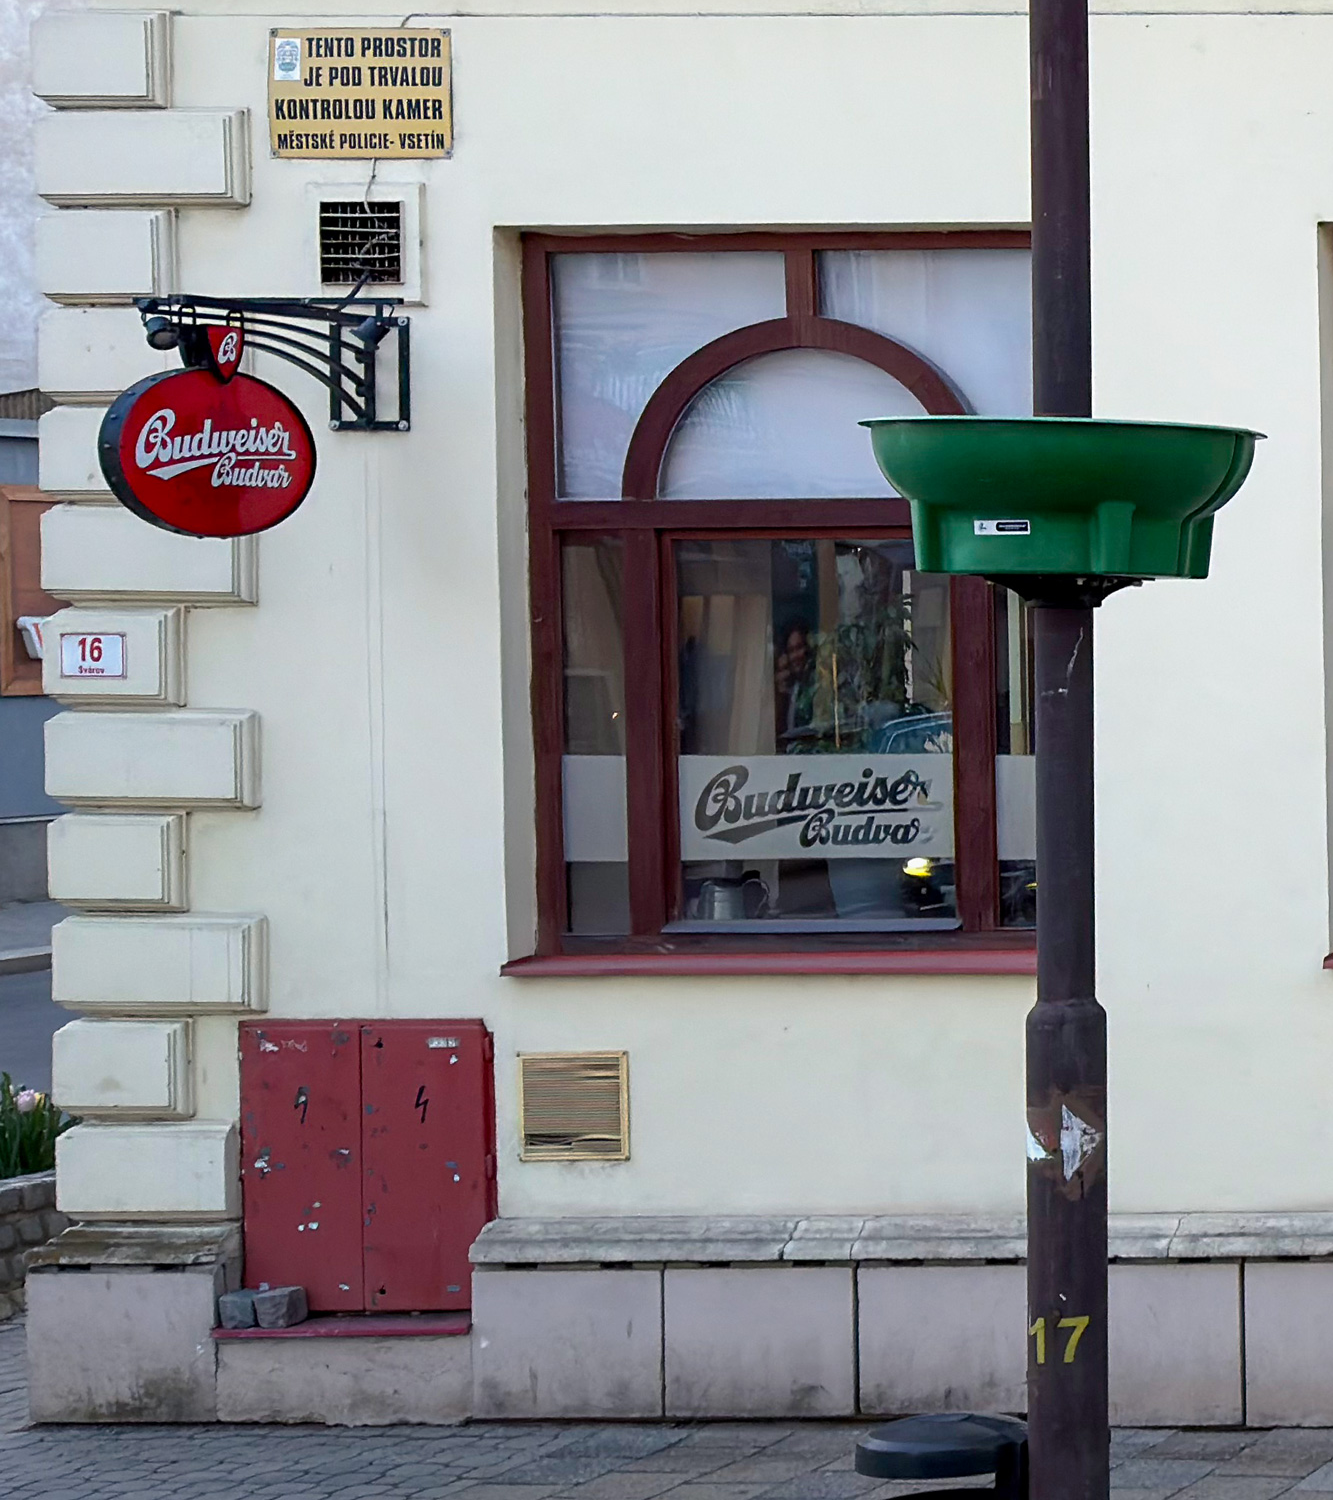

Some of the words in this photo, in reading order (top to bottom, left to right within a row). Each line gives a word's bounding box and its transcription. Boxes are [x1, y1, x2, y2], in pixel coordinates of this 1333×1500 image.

[305, 37, 355, 58] TENTO
[361, 37, 442, 58] PROSTOR
[303, 66, 323, 87] JE
[328, 66, 362, 87] POD
[368, 66, 443, 87] TRVALOU
[274, 98, 376, 120] KONTROLOU
[382, 98, 443, 120] KAMER
[277, 130, 336, 150] MĚSTSKÉ
[398, 130, 446, 150] VSETÍN
[135, 408, 297, 470] Budweiser
[210, 451, 293, 489] Budvar
[77, 637, 103, 663] 16
[694, 764, 945, 832] Budweiser
[1028, 1315, 1091, 1365] 17
